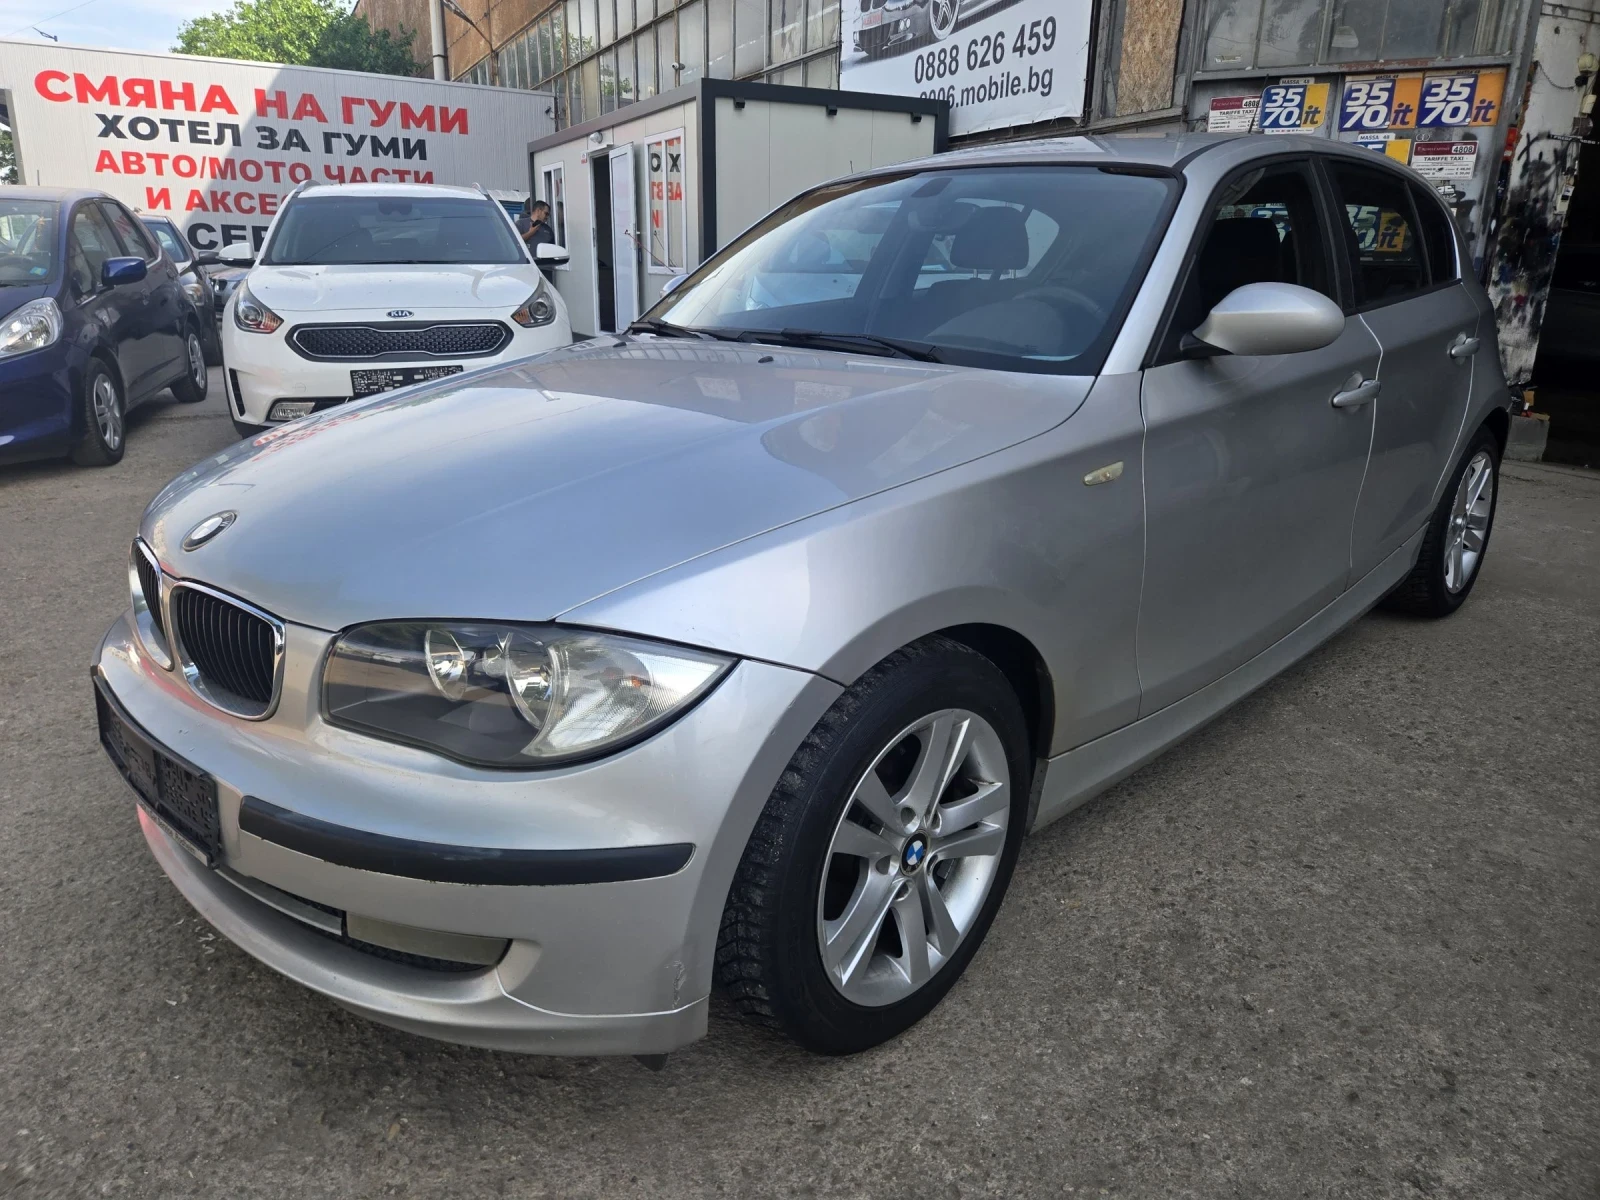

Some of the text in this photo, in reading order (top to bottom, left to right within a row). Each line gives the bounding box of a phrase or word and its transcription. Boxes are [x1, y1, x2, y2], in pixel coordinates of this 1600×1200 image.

[914, 15, 1057, 84] 0888 626 459
[34, 69, 469, 135] СМЯНА НА ГУМИ
[1265, 88, 1304, 107] 35
[1346, 82, 1393, 106] 35
[1424, 78, 1475, 102] 35
[1243, 100, 1260, 108] 4808
[95, 113, 427, 160] ХОТЕЛ ЗА ГУМИ
[1453, 145, 1473, 153] 4808
[95, 150, 312, 185] АВТО/МОТО
[145, 187, 171, 211] И
